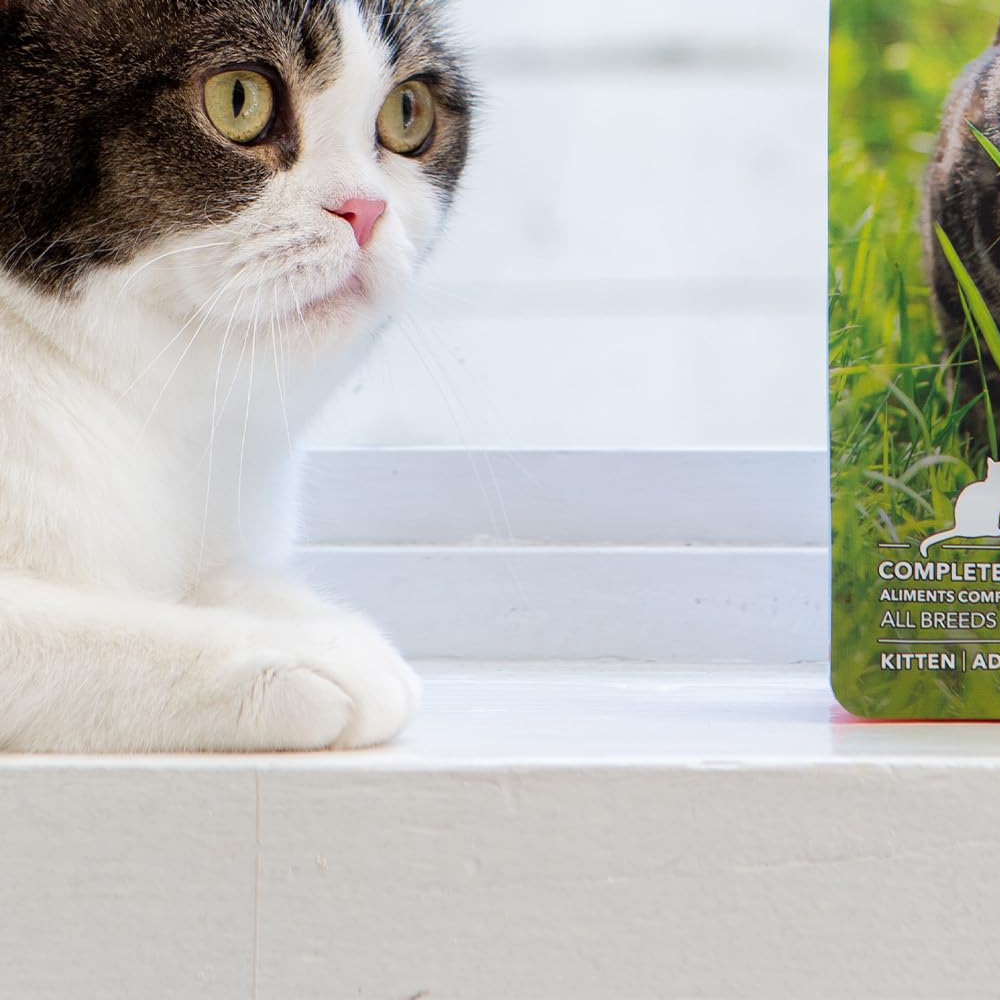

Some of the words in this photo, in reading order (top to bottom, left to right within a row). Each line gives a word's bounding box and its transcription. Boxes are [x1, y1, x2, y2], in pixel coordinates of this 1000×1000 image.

[880, 589, 955, 603] ALIMENTS
[880, 611, 916, 629] ALL
[920, 611, 997, 629] BREEDS
[880, 653, 955, 670] KITTEN
